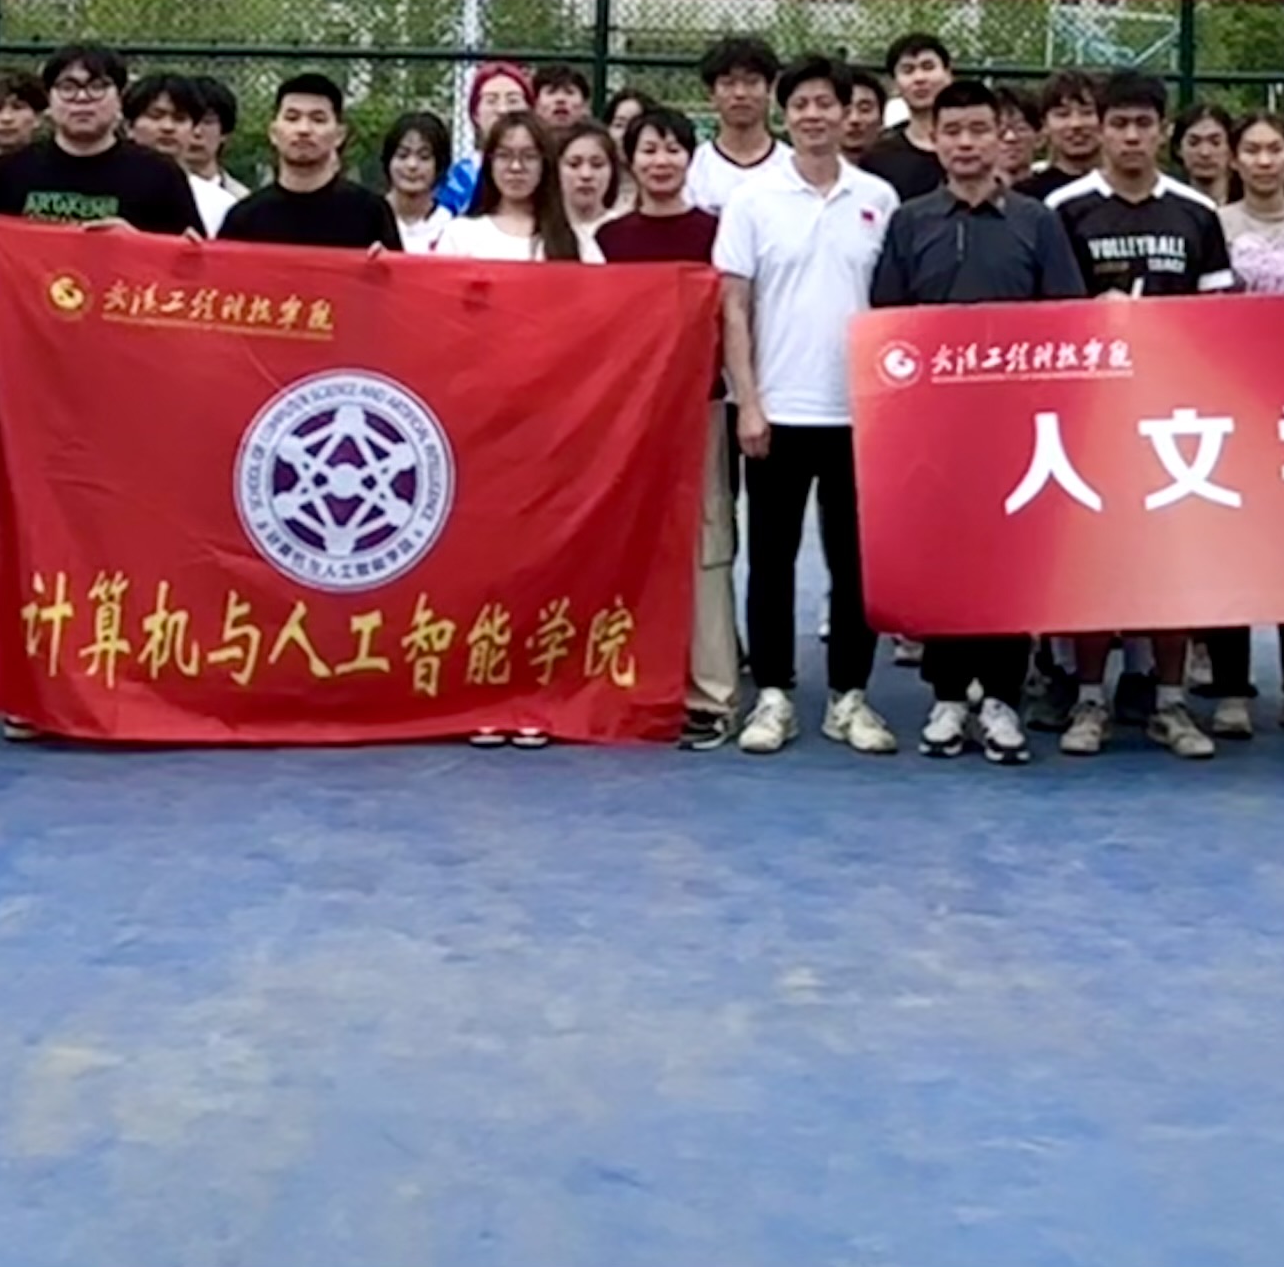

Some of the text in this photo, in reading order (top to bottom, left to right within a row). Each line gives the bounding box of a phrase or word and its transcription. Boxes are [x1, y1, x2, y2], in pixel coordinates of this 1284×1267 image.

[21, 571, 635, 698] 计算机与人工智能学院
